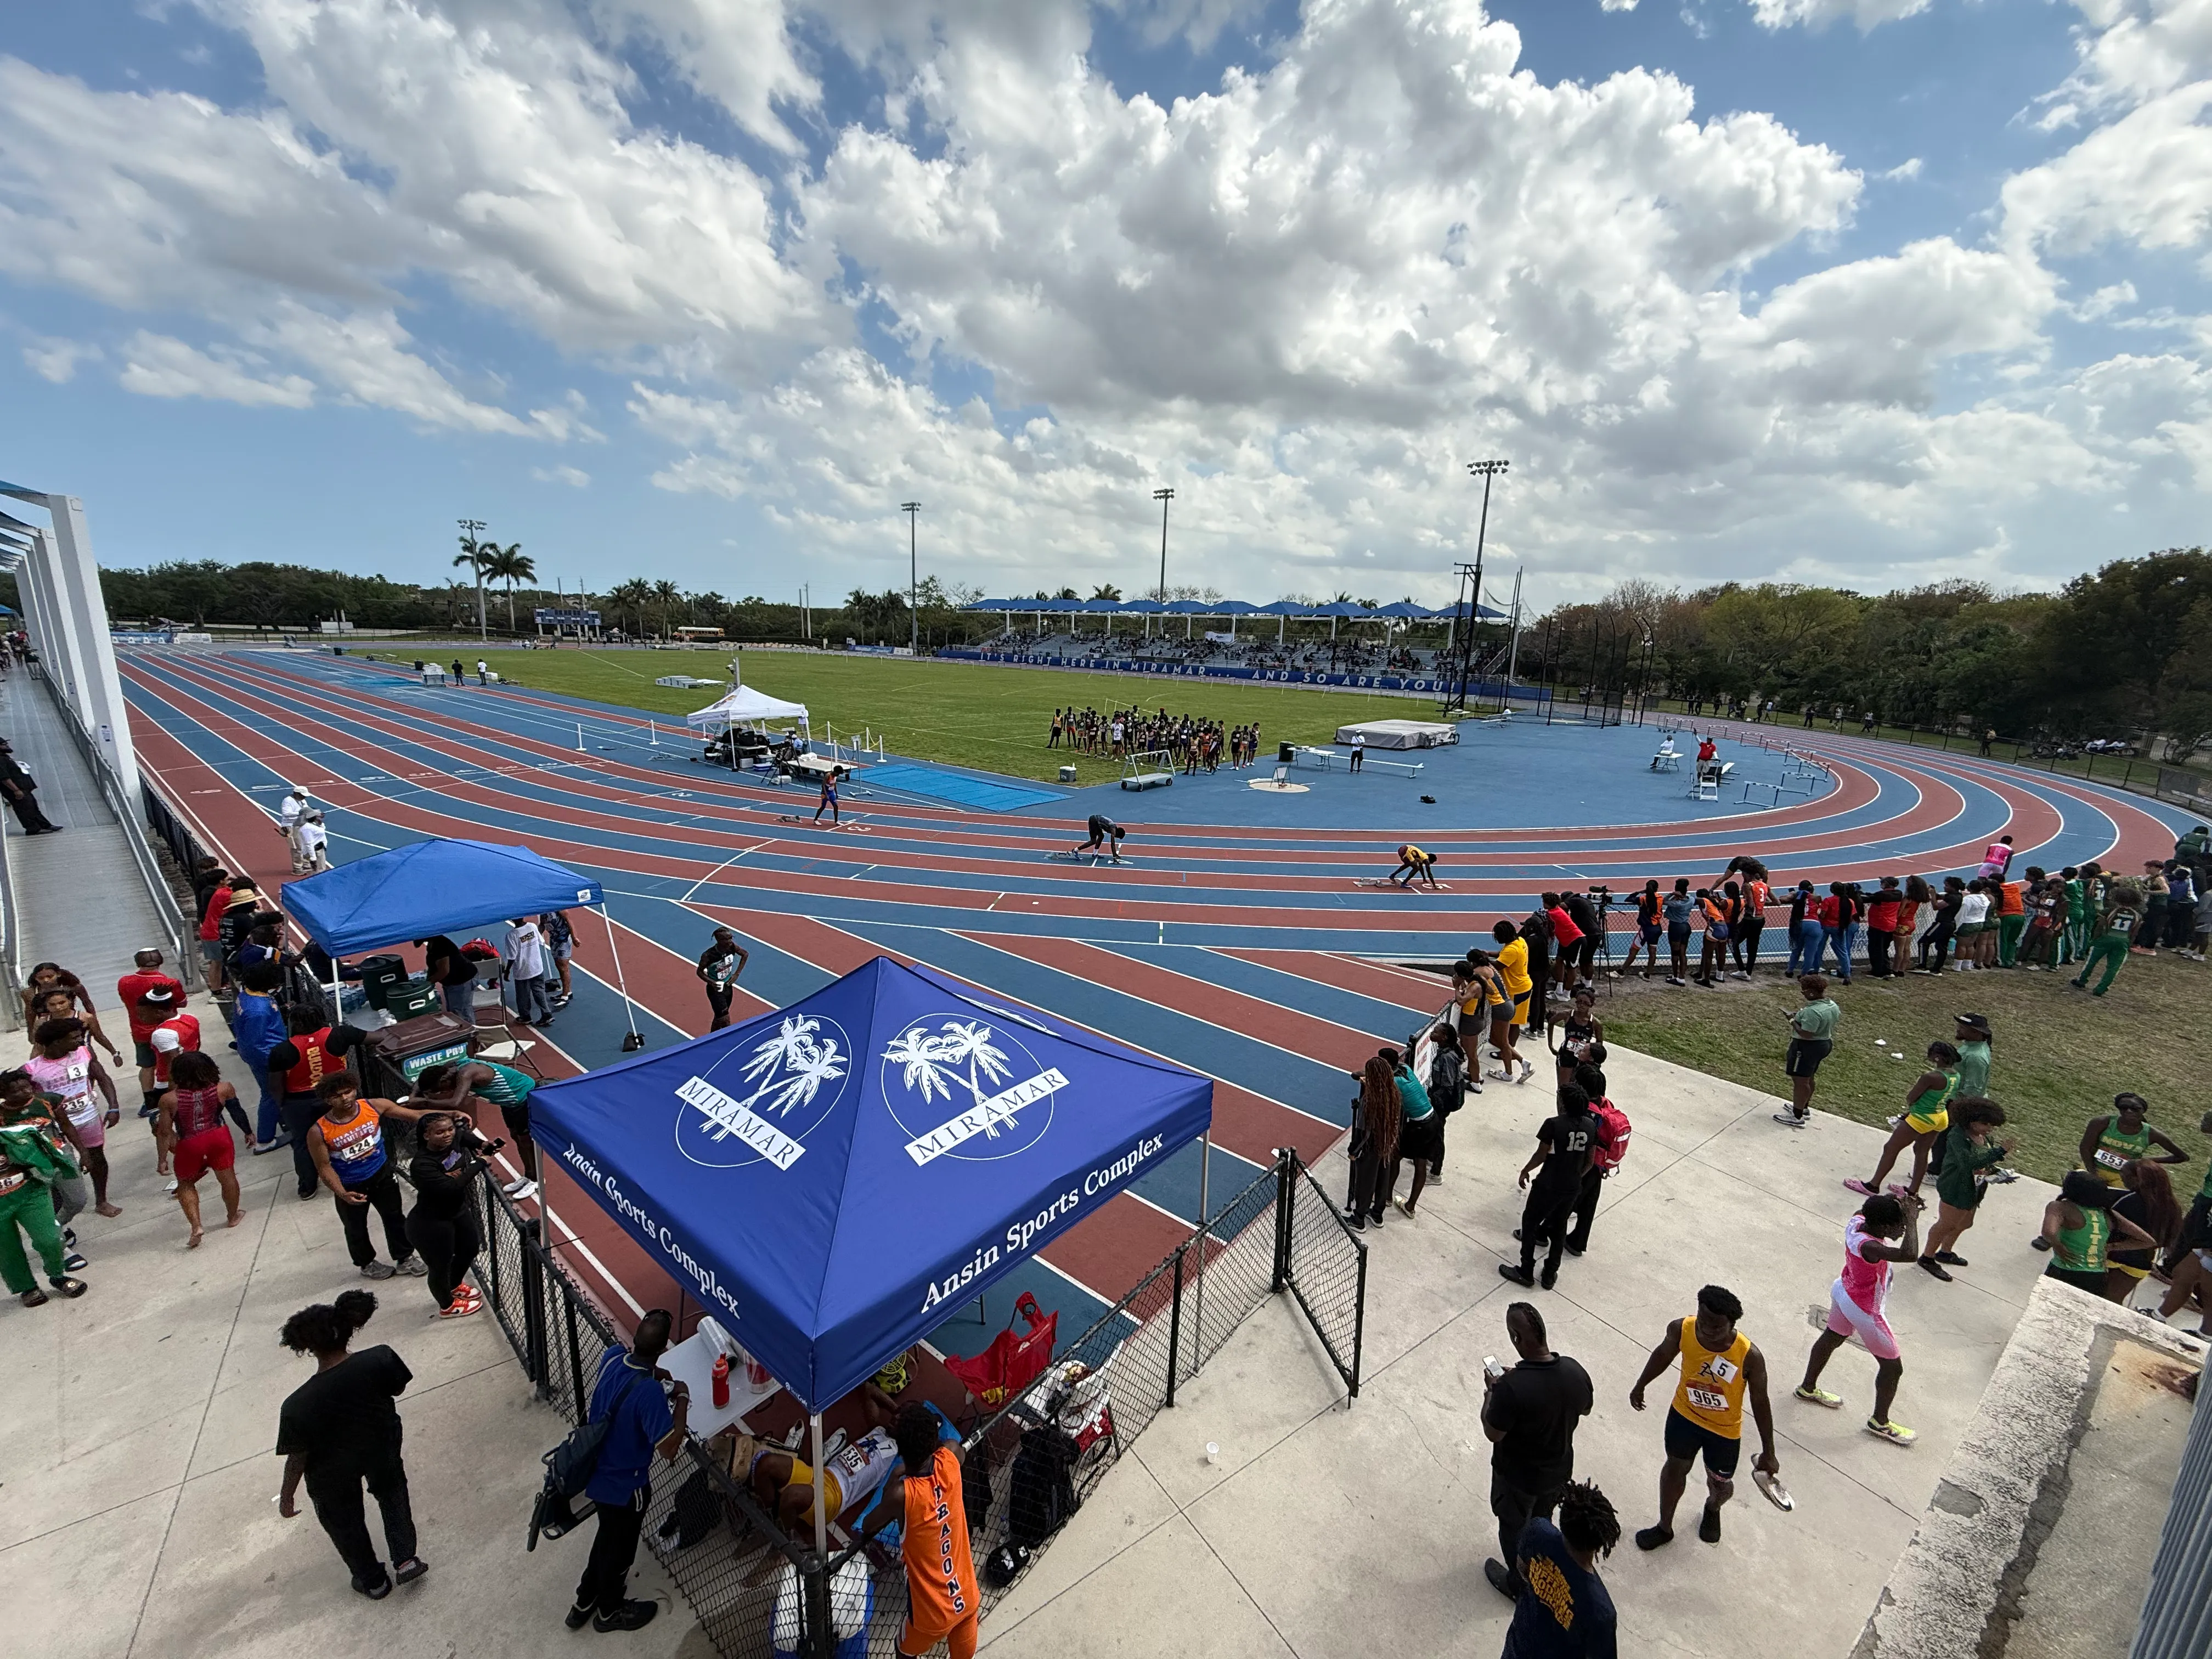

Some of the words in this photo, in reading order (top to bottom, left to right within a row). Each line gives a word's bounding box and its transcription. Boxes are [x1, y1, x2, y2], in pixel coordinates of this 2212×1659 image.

[980, 653, 1005, 661] IT'S
[1013, 654, 1052, 665] RIGHT
[1061, 658, 1096, 668] HERE
[1105, 660, 1120, 669] IN
[1252, 670, 1289, 681] AND
[1303, 673, 1327, 684] SO
[1341, 675, 1381, 687] ARE
[1759, 887, 1765, 902] 3
[2112, 918, 2131, 932] 11
[409, 1052, 442, 1069] WASTE
[72, 1066, 81, 1077] 3
[681, 1081, 795, 1165] MIRAMAR
[913, 1073, 1064, 1160] MIRAMAR
[348, 1139, 371, 1154] 424
[1566, 1131, 1588, 1151] 12
[2101, 1152, 2124, 1166] 653
[563, 1142, 603, 1190] Ansin
[605, 1176, 657, 1239] Sports
[659, 1227, 741, 1321] Complex
[921, 1245, 1000, 1314] Ansin
[1006, 1188, 1080, 1253] Sports
[1084, 1132, 1163, 1195] Complex
[1717, 1362, 1729, 1377] 5
[1692, 1390, 1722, 1407] 965
[843, 1447, 863, 1469] 535
